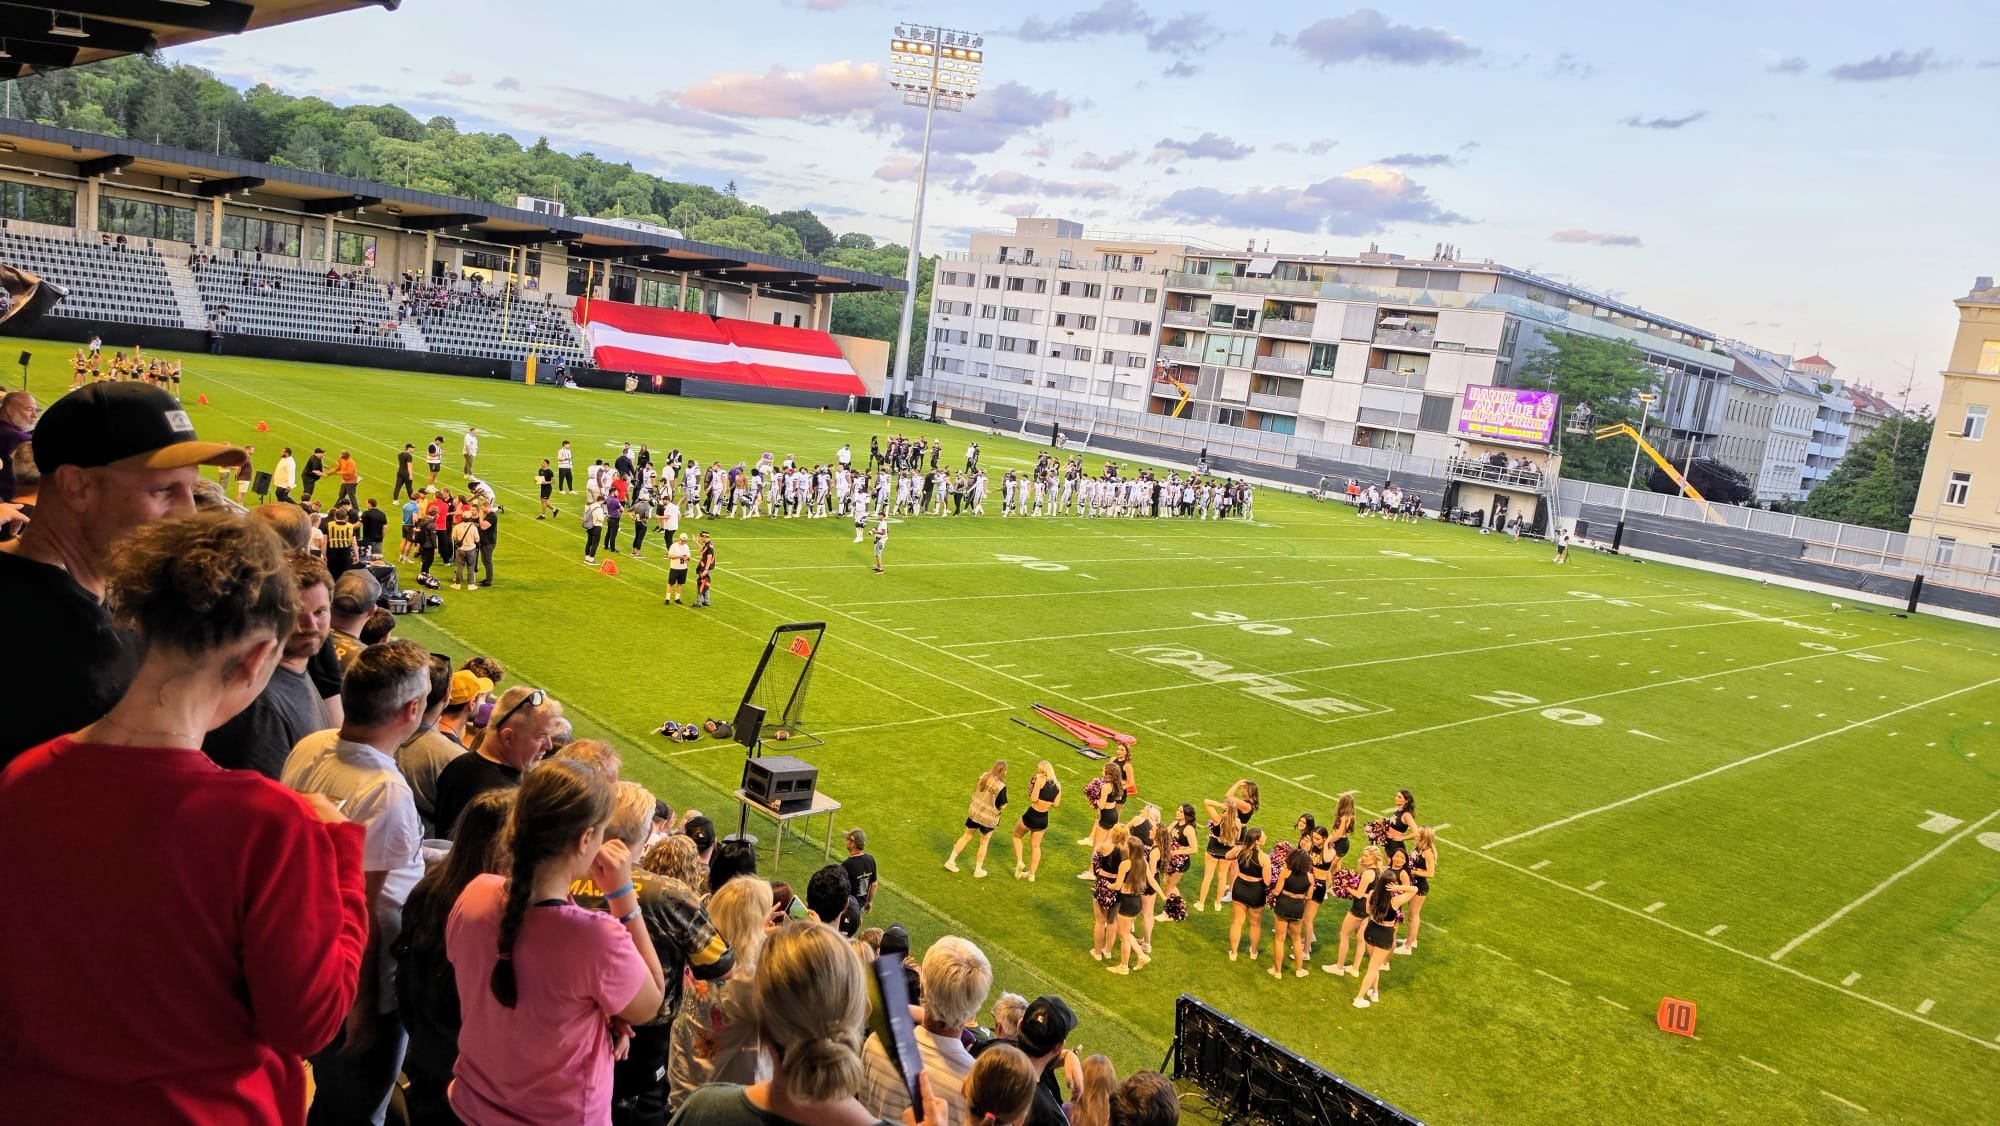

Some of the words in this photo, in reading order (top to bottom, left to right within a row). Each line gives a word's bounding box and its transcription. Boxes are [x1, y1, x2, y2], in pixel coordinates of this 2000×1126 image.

[1469, 387, 1517, 403] DANKE
[1473, 400, 1494, 414] AN
[1497, 402, 1534, 418] ALLE
[1191, 610, 1293, 635] 30
[791, 637, 804, 654] 30
[1470, 690, 1605, 726] 20
[1667, 1003, 1691, 1032] 10
